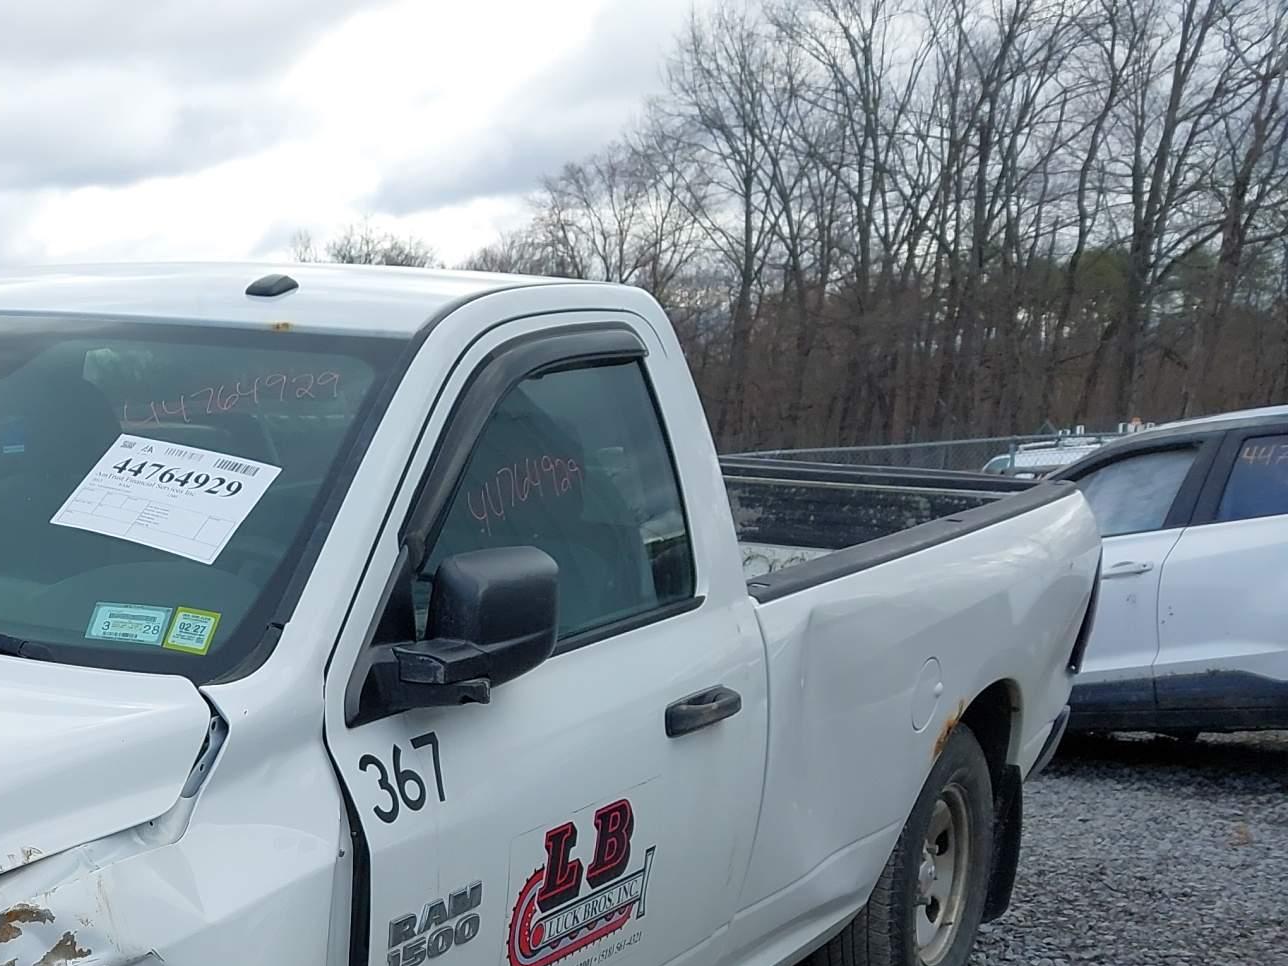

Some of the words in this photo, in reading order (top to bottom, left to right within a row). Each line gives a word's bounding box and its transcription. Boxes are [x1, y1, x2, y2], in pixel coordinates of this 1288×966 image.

[123, 371, 340, 424] 44764929
[113, 457, 243, 498] 44764929
[467, 455, 584, 536] 44764929
[101, 620, 111, 631] 3
[142, 624, 160, 635] 28
[178, 622, 192, 632] 02
[194, 623, 208, 634] 27
[358, 731, 446, 824] 367
[388, 880, 482, 950] RAM
[548, 908, 581, 938] LUCK
[617, 879, 639, 905] INC.
